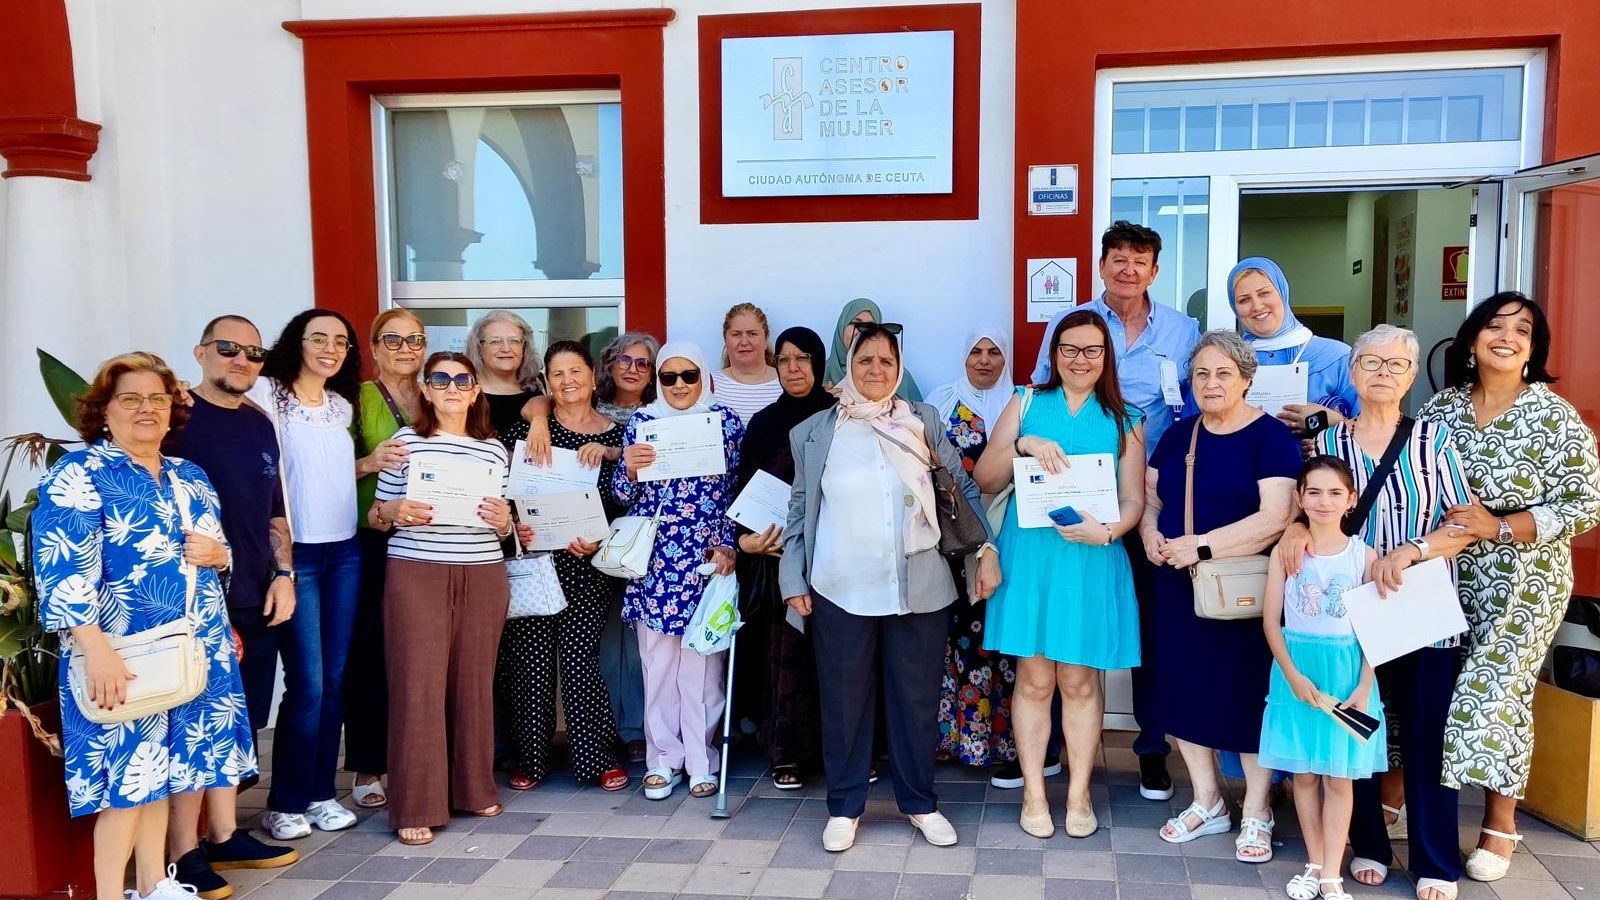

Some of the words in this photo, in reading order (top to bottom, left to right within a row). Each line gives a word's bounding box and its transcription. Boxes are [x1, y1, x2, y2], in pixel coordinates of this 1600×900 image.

[820, 55, 909, 74] CENTRO
[819, 77, 909, 95] ASESOR
[820, 99, 848, 116] DE
[856, 98, 884, 115] LA
[819, 119, 894, 137] MUJER
[748, 175, 792, 185] CIUDAD
[795, 172, 863, 184] AUTÓNOMA
[866, 173, 882, 183] DE
[885, 172, 925, 182] CEUTA
